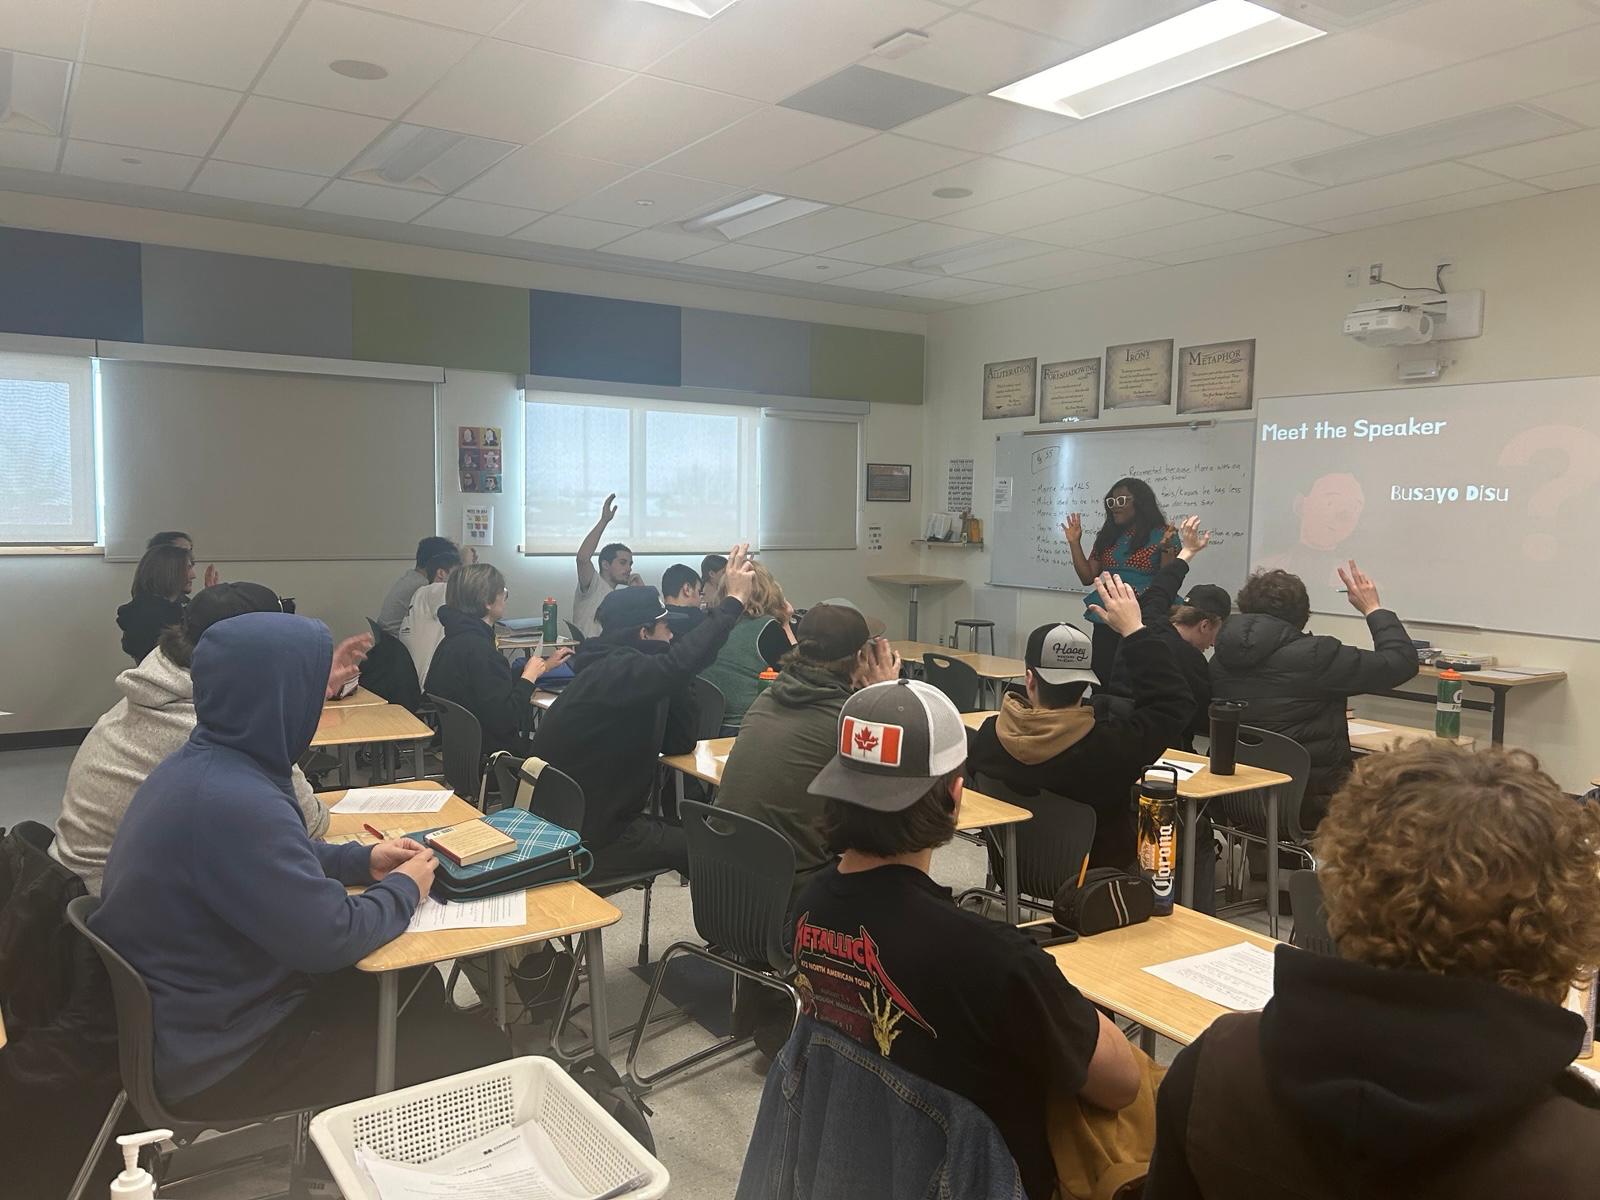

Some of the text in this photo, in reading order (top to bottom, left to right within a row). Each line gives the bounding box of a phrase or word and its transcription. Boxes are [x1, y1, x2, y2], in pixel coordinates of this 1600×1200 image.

[1189, 350, 1241, 366] METAPHOR
[1261, 416, 1447, 441] Meet the Speaker
[1390, 485, 1509, 503] Busayo Disu
[1053, 642, 1089, 662] Hooey
[1151, 823, 1175, 897] Corona
[809, 962, 826, 974] NORTH
[826, 968, 854, 983] AMERICAN
[855, 977, 871, 990] TOUR
